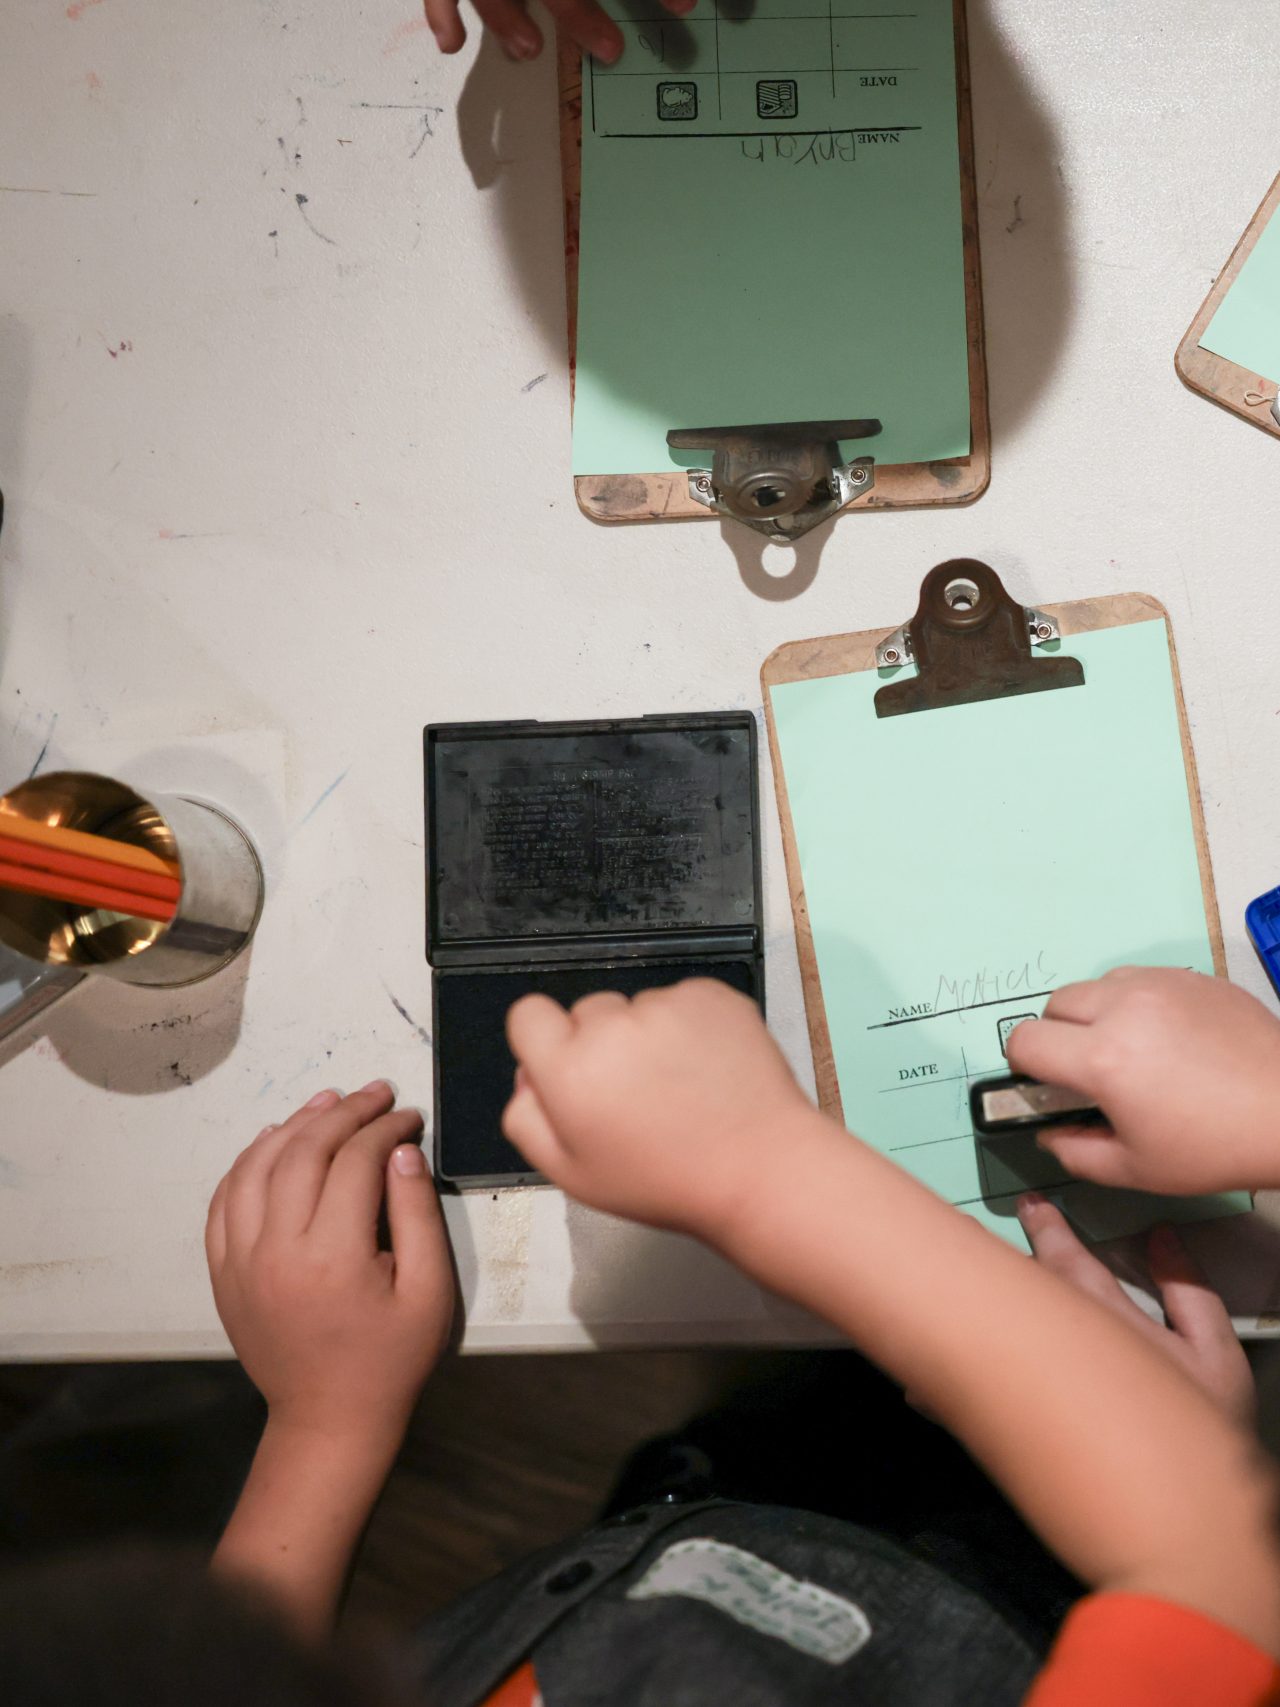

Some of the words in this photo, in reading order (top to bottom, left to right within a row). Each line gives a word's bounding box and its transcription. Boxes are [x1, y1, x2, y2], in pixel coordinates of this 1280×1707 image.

[859, 76, 898, 88] DATE
[857, 132, 900, 145] NAME
[887, 1002, 933, 1020] NAME
[899, 1063, 939, 1081] DATE
